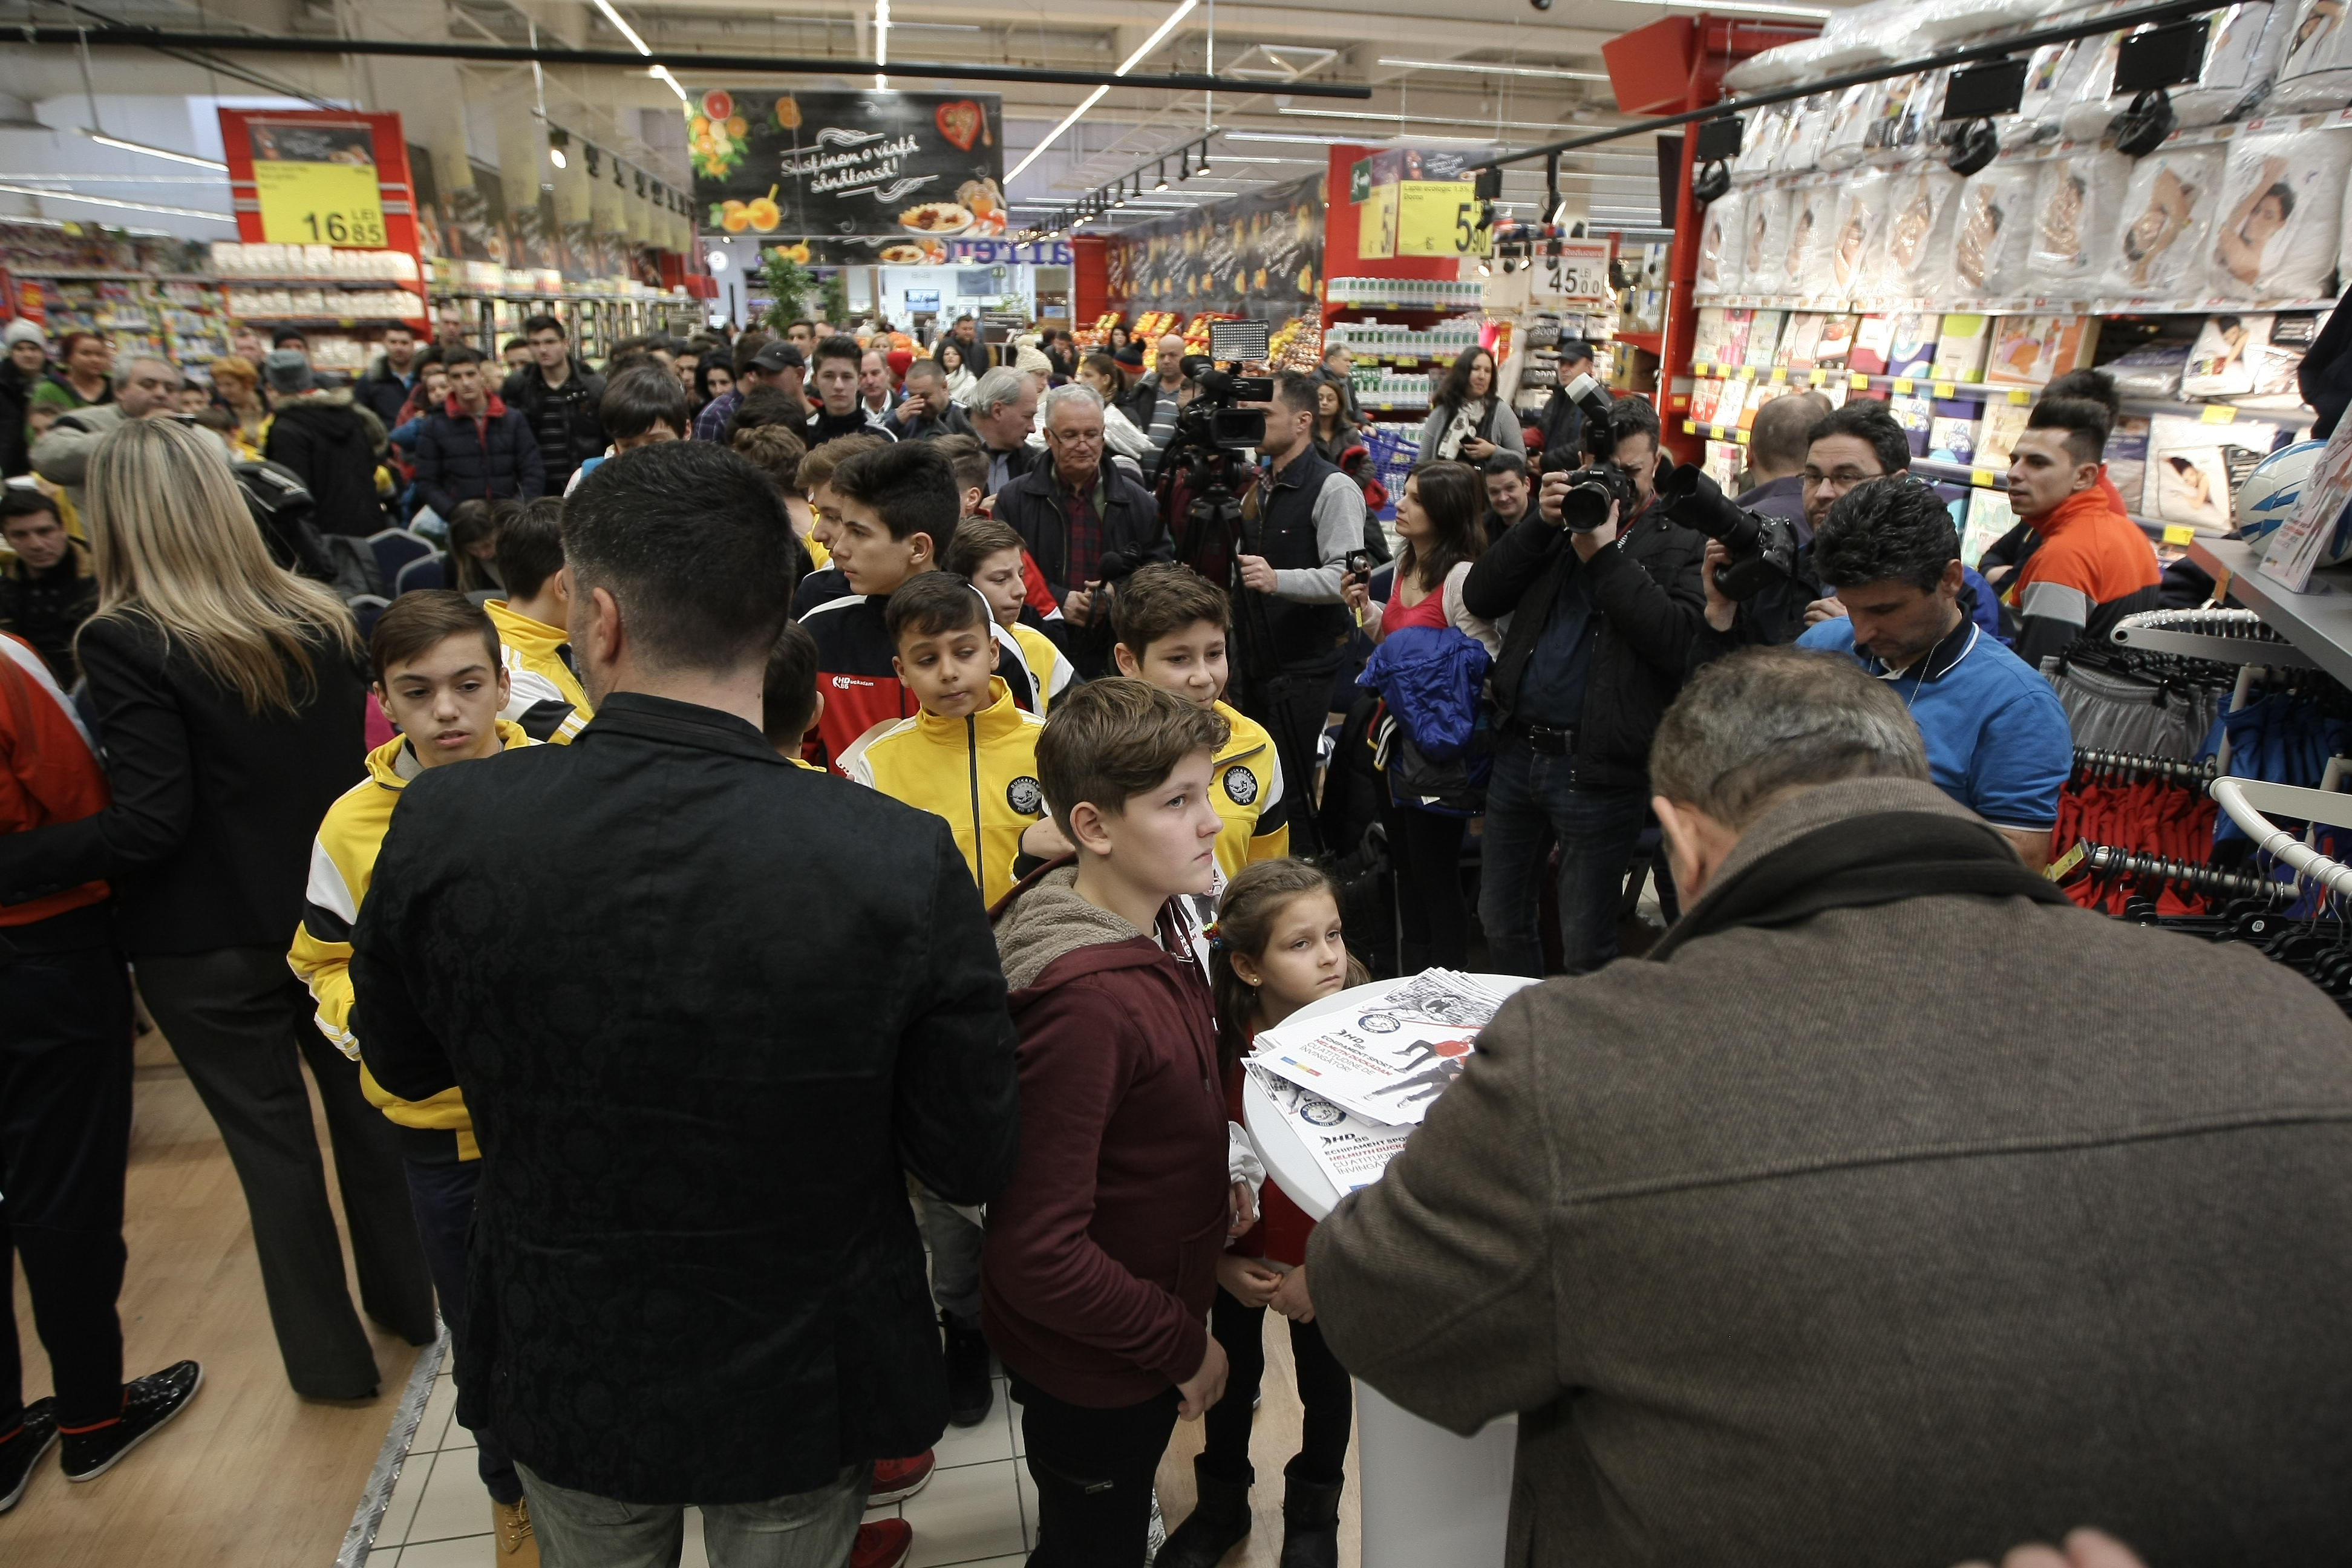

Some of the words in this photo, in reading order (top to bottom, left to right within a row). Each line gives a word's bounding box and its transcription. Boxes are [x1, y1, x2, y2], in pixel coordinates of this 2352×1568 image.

[861, 148, 872, 162] o
[303, 212, 347, 242] 16
[351, 223, 382, 243] 85
[1455, 203, 1472, 252] 5
[1549, 268, 1578, 293] 45
[1581, 280, 1600, 294] 00
[1580, 268, 1592, 278] LEI
[1324, 1140, 1386, 1156] ECHIPAMENT
[1329, 1149, 1376, 1161] HELMUTH
[1376, 1143, 1407, 1153] DUCKA
